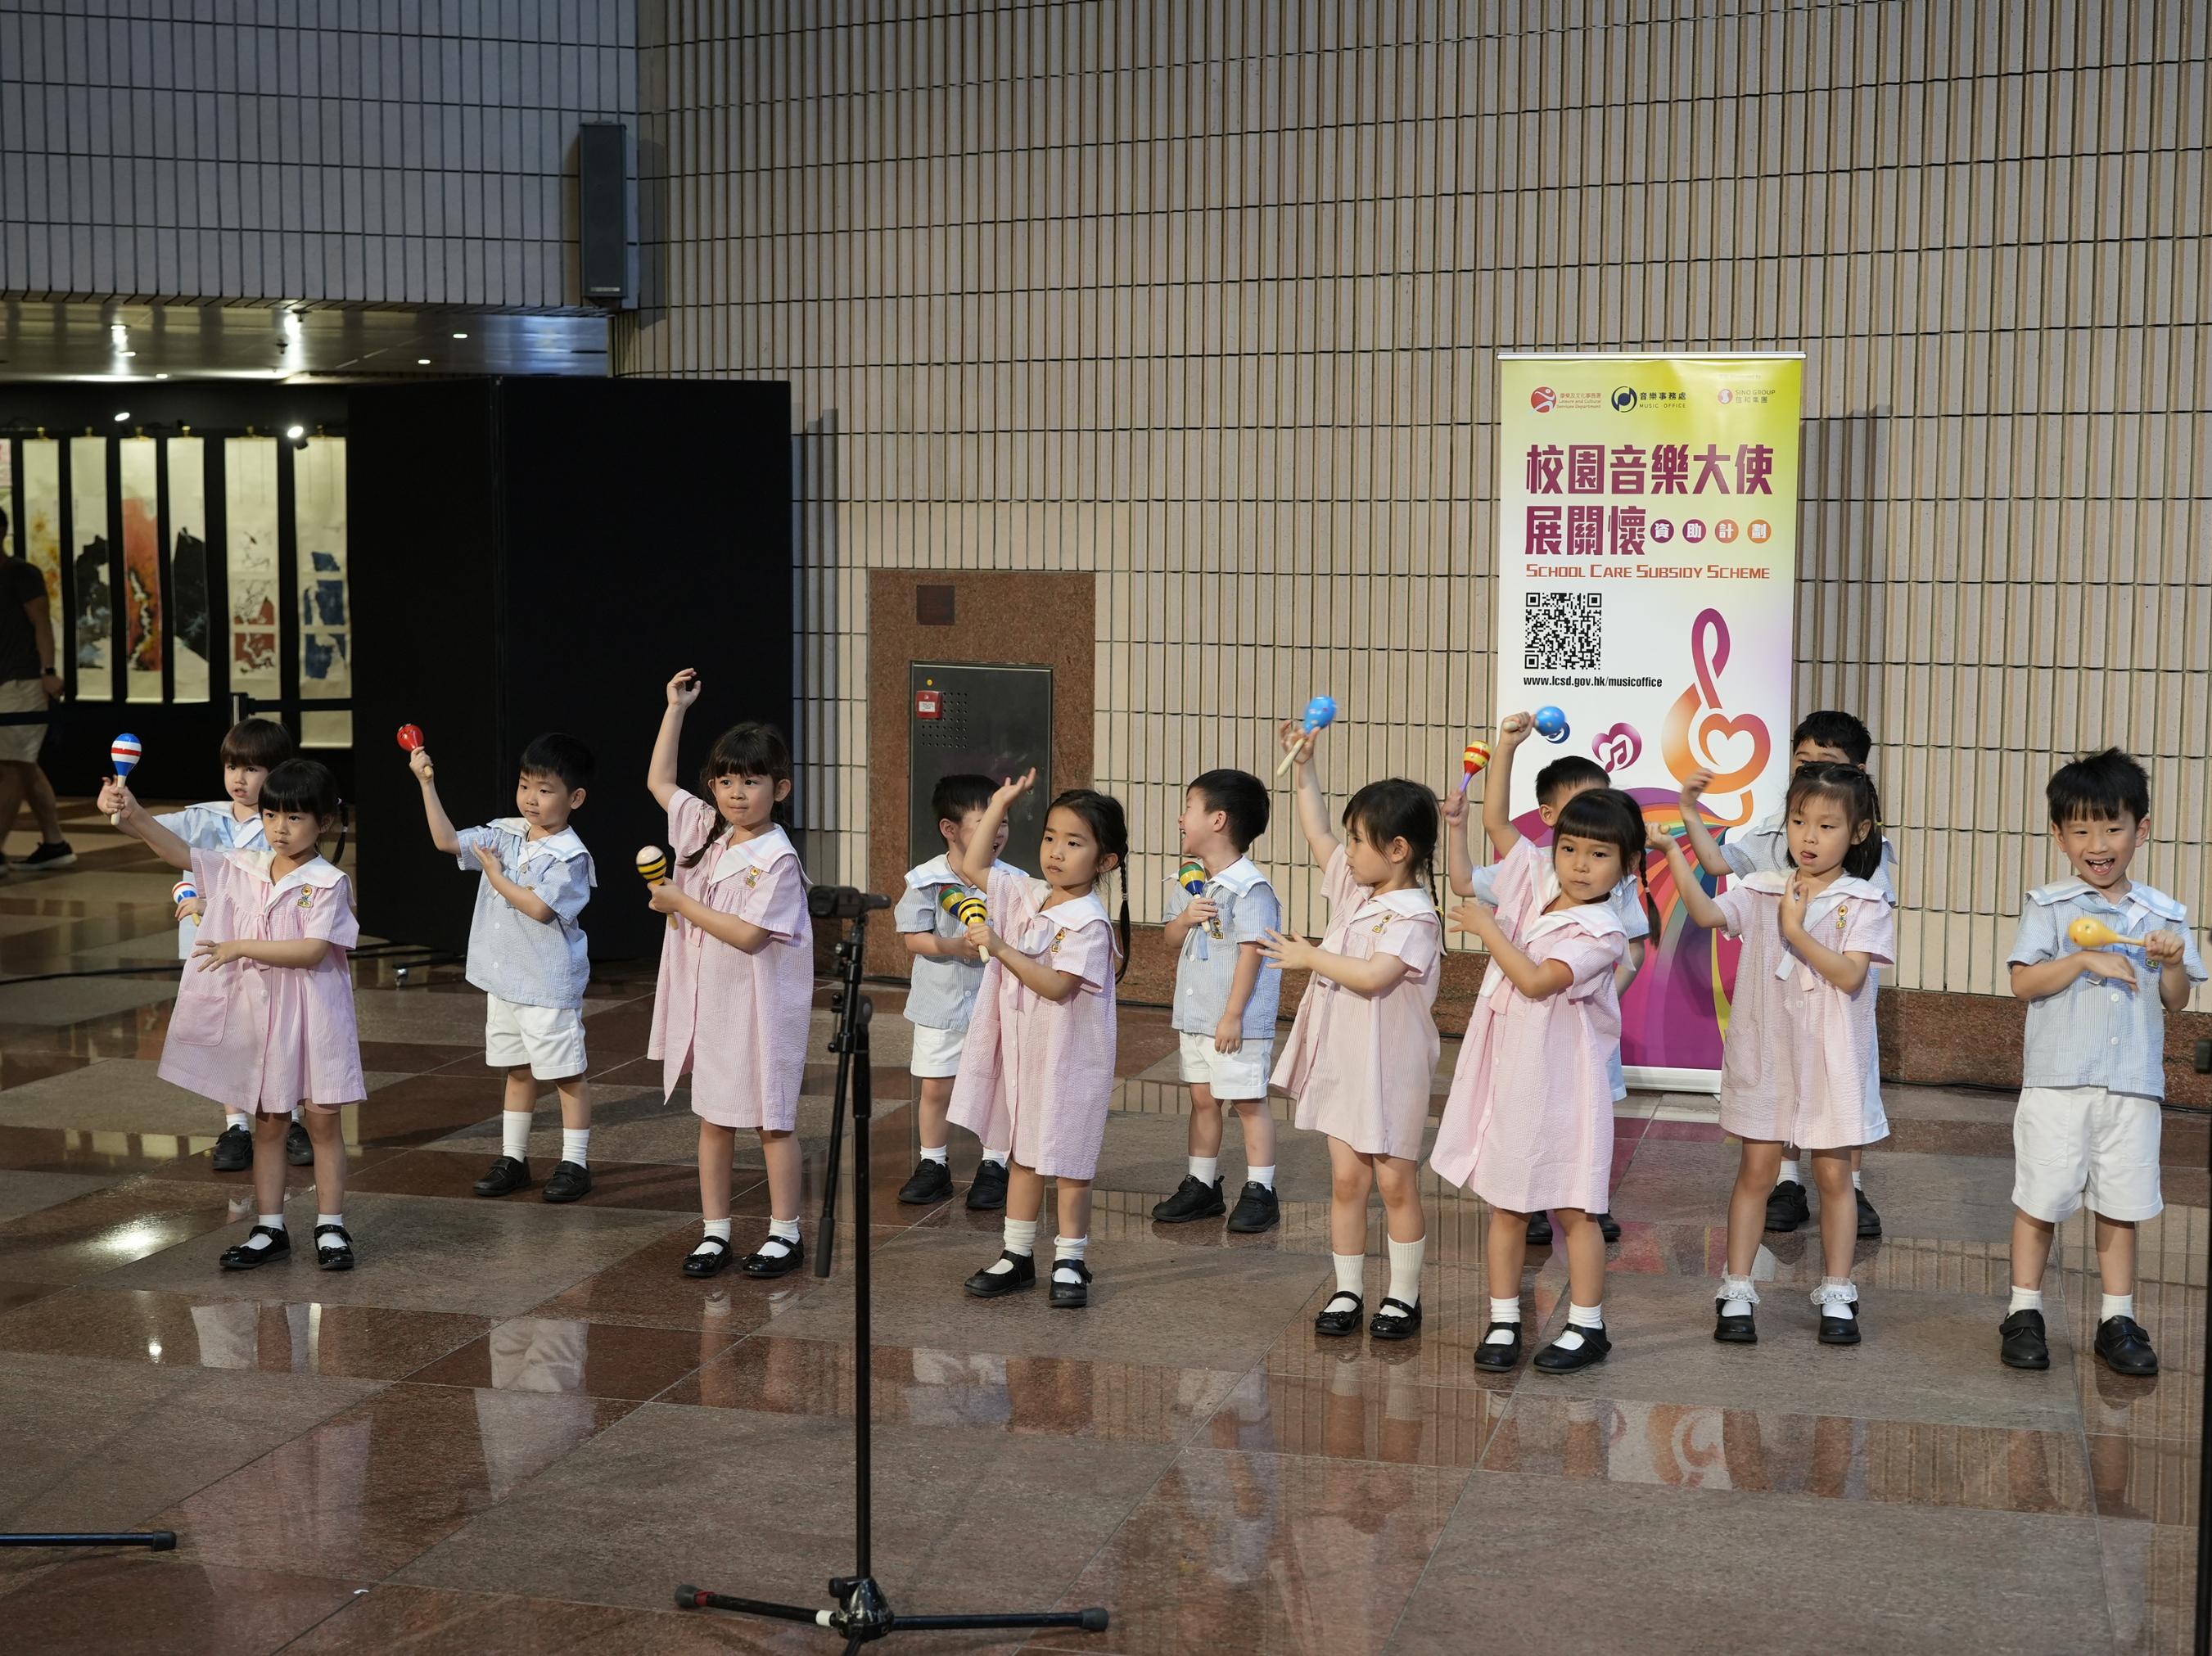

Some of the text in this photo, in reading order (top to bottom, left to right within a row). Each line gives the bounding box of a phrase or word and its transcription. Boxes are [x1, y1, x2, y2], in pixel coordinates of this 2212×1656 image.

[1639, 391, 1686, 400] 音樂事務處
[1526, 443, 1774, 495] 校園音樂大使
[1525, 505, 1646, 556] 展關懷
[1523, 675, 1664, 688] www.lcsd.gov.hk/musicoffice
